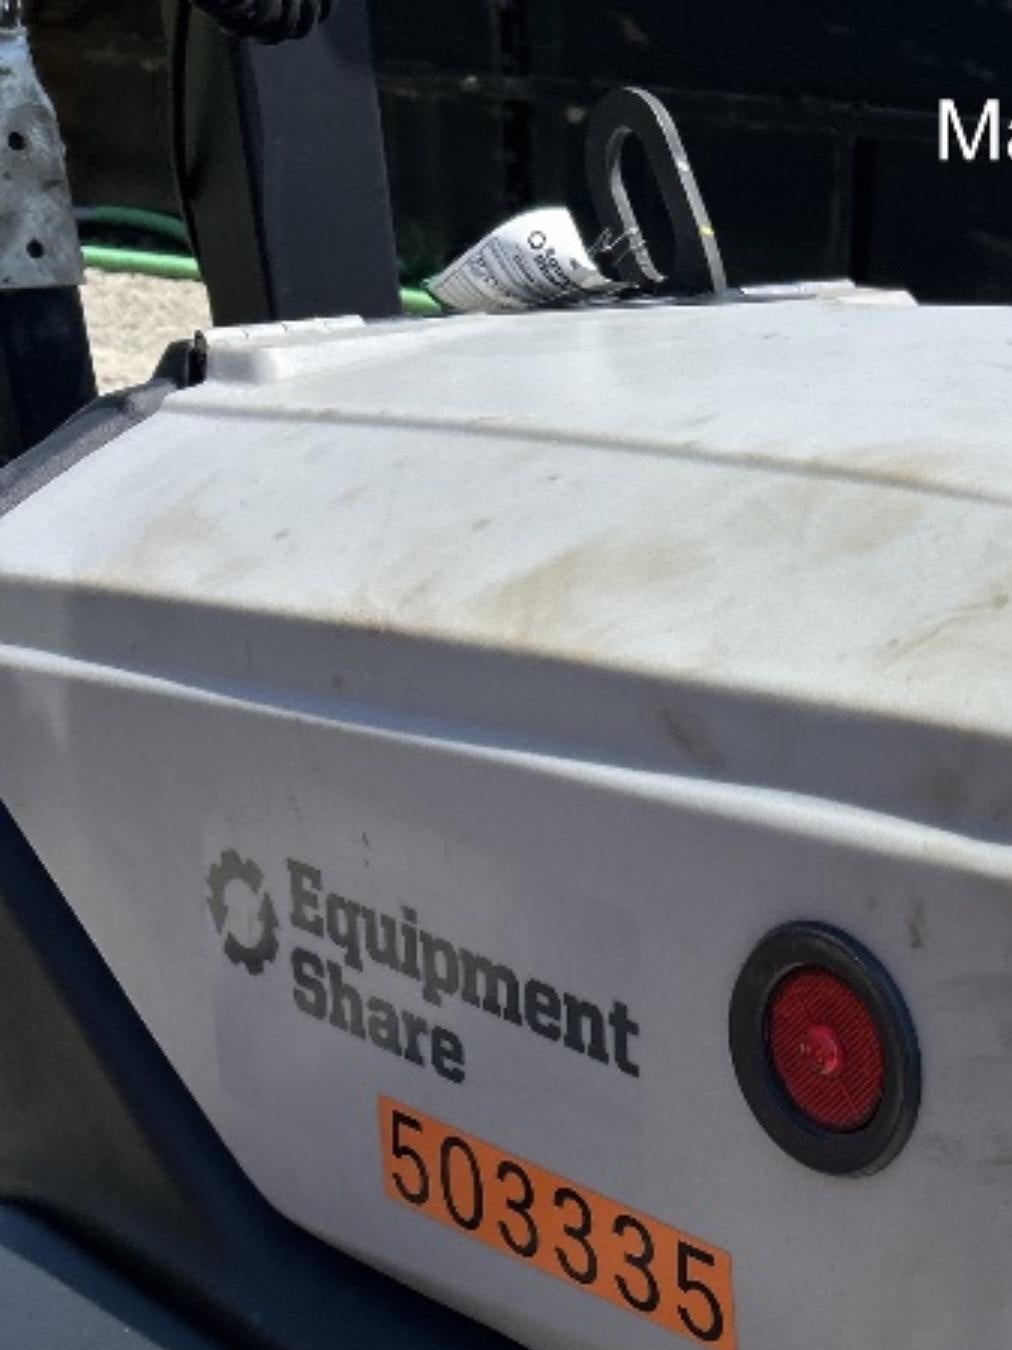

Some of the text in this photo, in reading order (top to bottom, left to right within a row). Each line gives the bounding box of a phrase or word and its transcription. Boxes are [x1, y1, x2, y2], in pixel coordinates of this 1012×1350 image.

[287, 857, 640, 1078] Equipment
[290, 946, 466, 1084] Share
[390, 1109, 725, 1342] 503335
